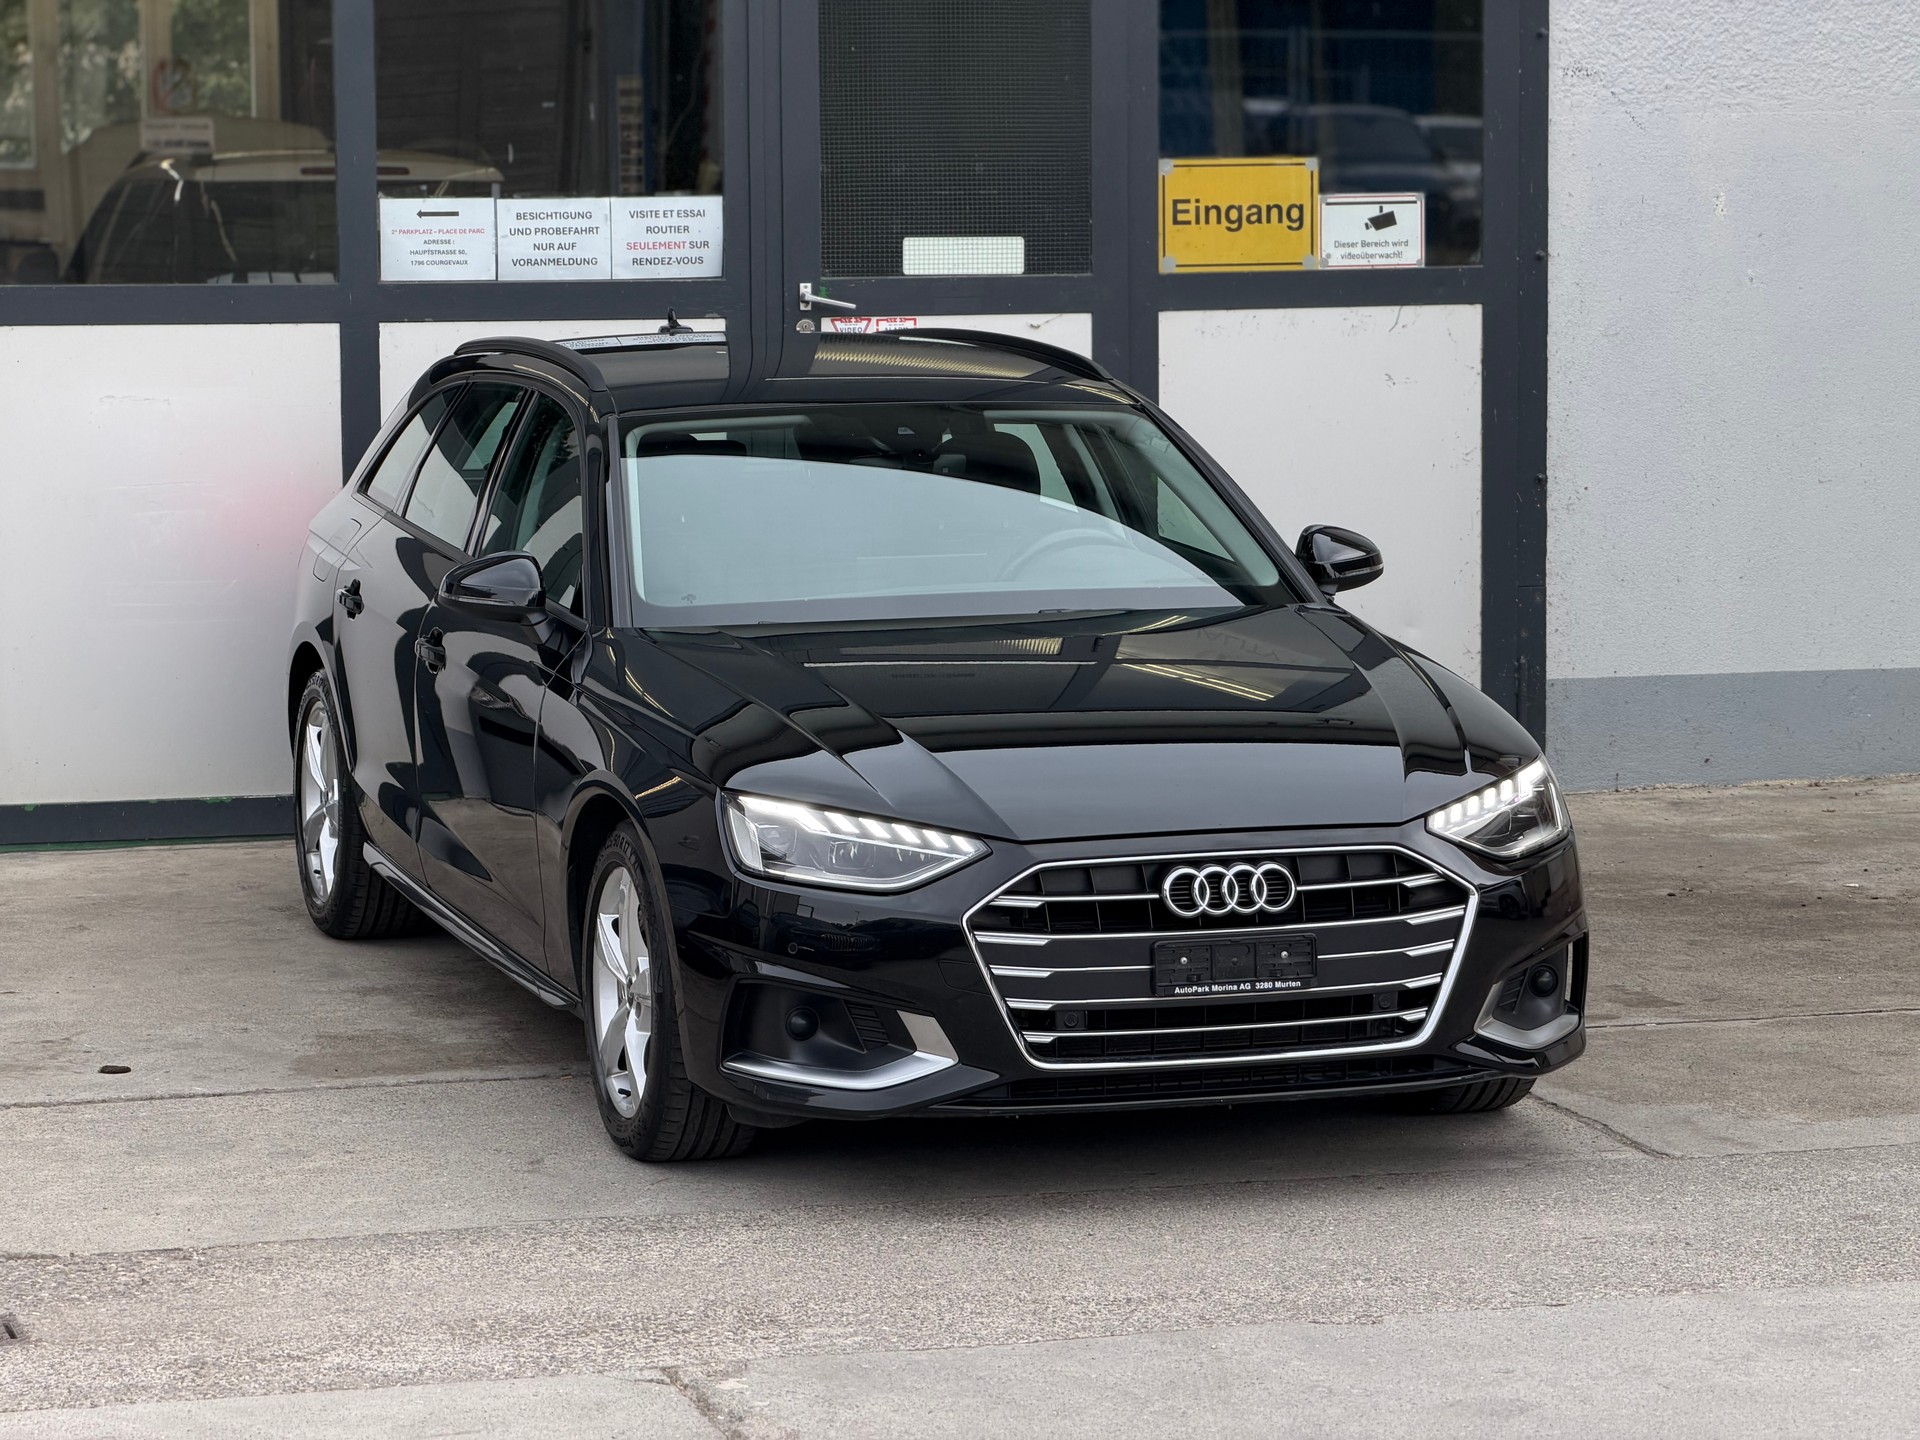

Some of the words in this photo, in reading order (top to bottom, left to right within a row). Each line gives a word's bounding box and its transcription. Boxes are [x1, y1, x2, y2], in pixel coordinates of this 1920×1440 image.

[516, 211, 593, 220] BESICHTIGUNG
[629, 210, 661, 219] VISITE
[663, 210, 674, 219] ET
[677, 209, 706, 218] ESSAI
[1172, 198, 1304, 232] Eingang
[509, 227, 532, 236] UND
[535, 227, 599, 236] PROBEFAHRT
[646, 225, 690, 234] ROUTIER
[533, 243, 555, 251] NUR
[557, 243, 577, 251] AUF
[626, 241, 686, 250] SEULEMENT
[688, 241, 710, 249] SUR
[1334, 240, 1359, 248] Dieser
[1361, 240, 1390, 248] Bereich
[1391, 239, 1408, 248] wird
[1340, 250, 1403, 260] videoüberwacht!
[511, 257, 598, 267] VORANMELDUNG
[632, 256, 704, 265] RENDEZ-VOUS
[1174, 985, 1210, 994] AutoPark
[1211, 984, 1238, 992] Morina
[1239, 982, 1251, 990] AG
[1255, 981, 1273, 989] 3280
[1275, 980, 1301, 988] Murten
